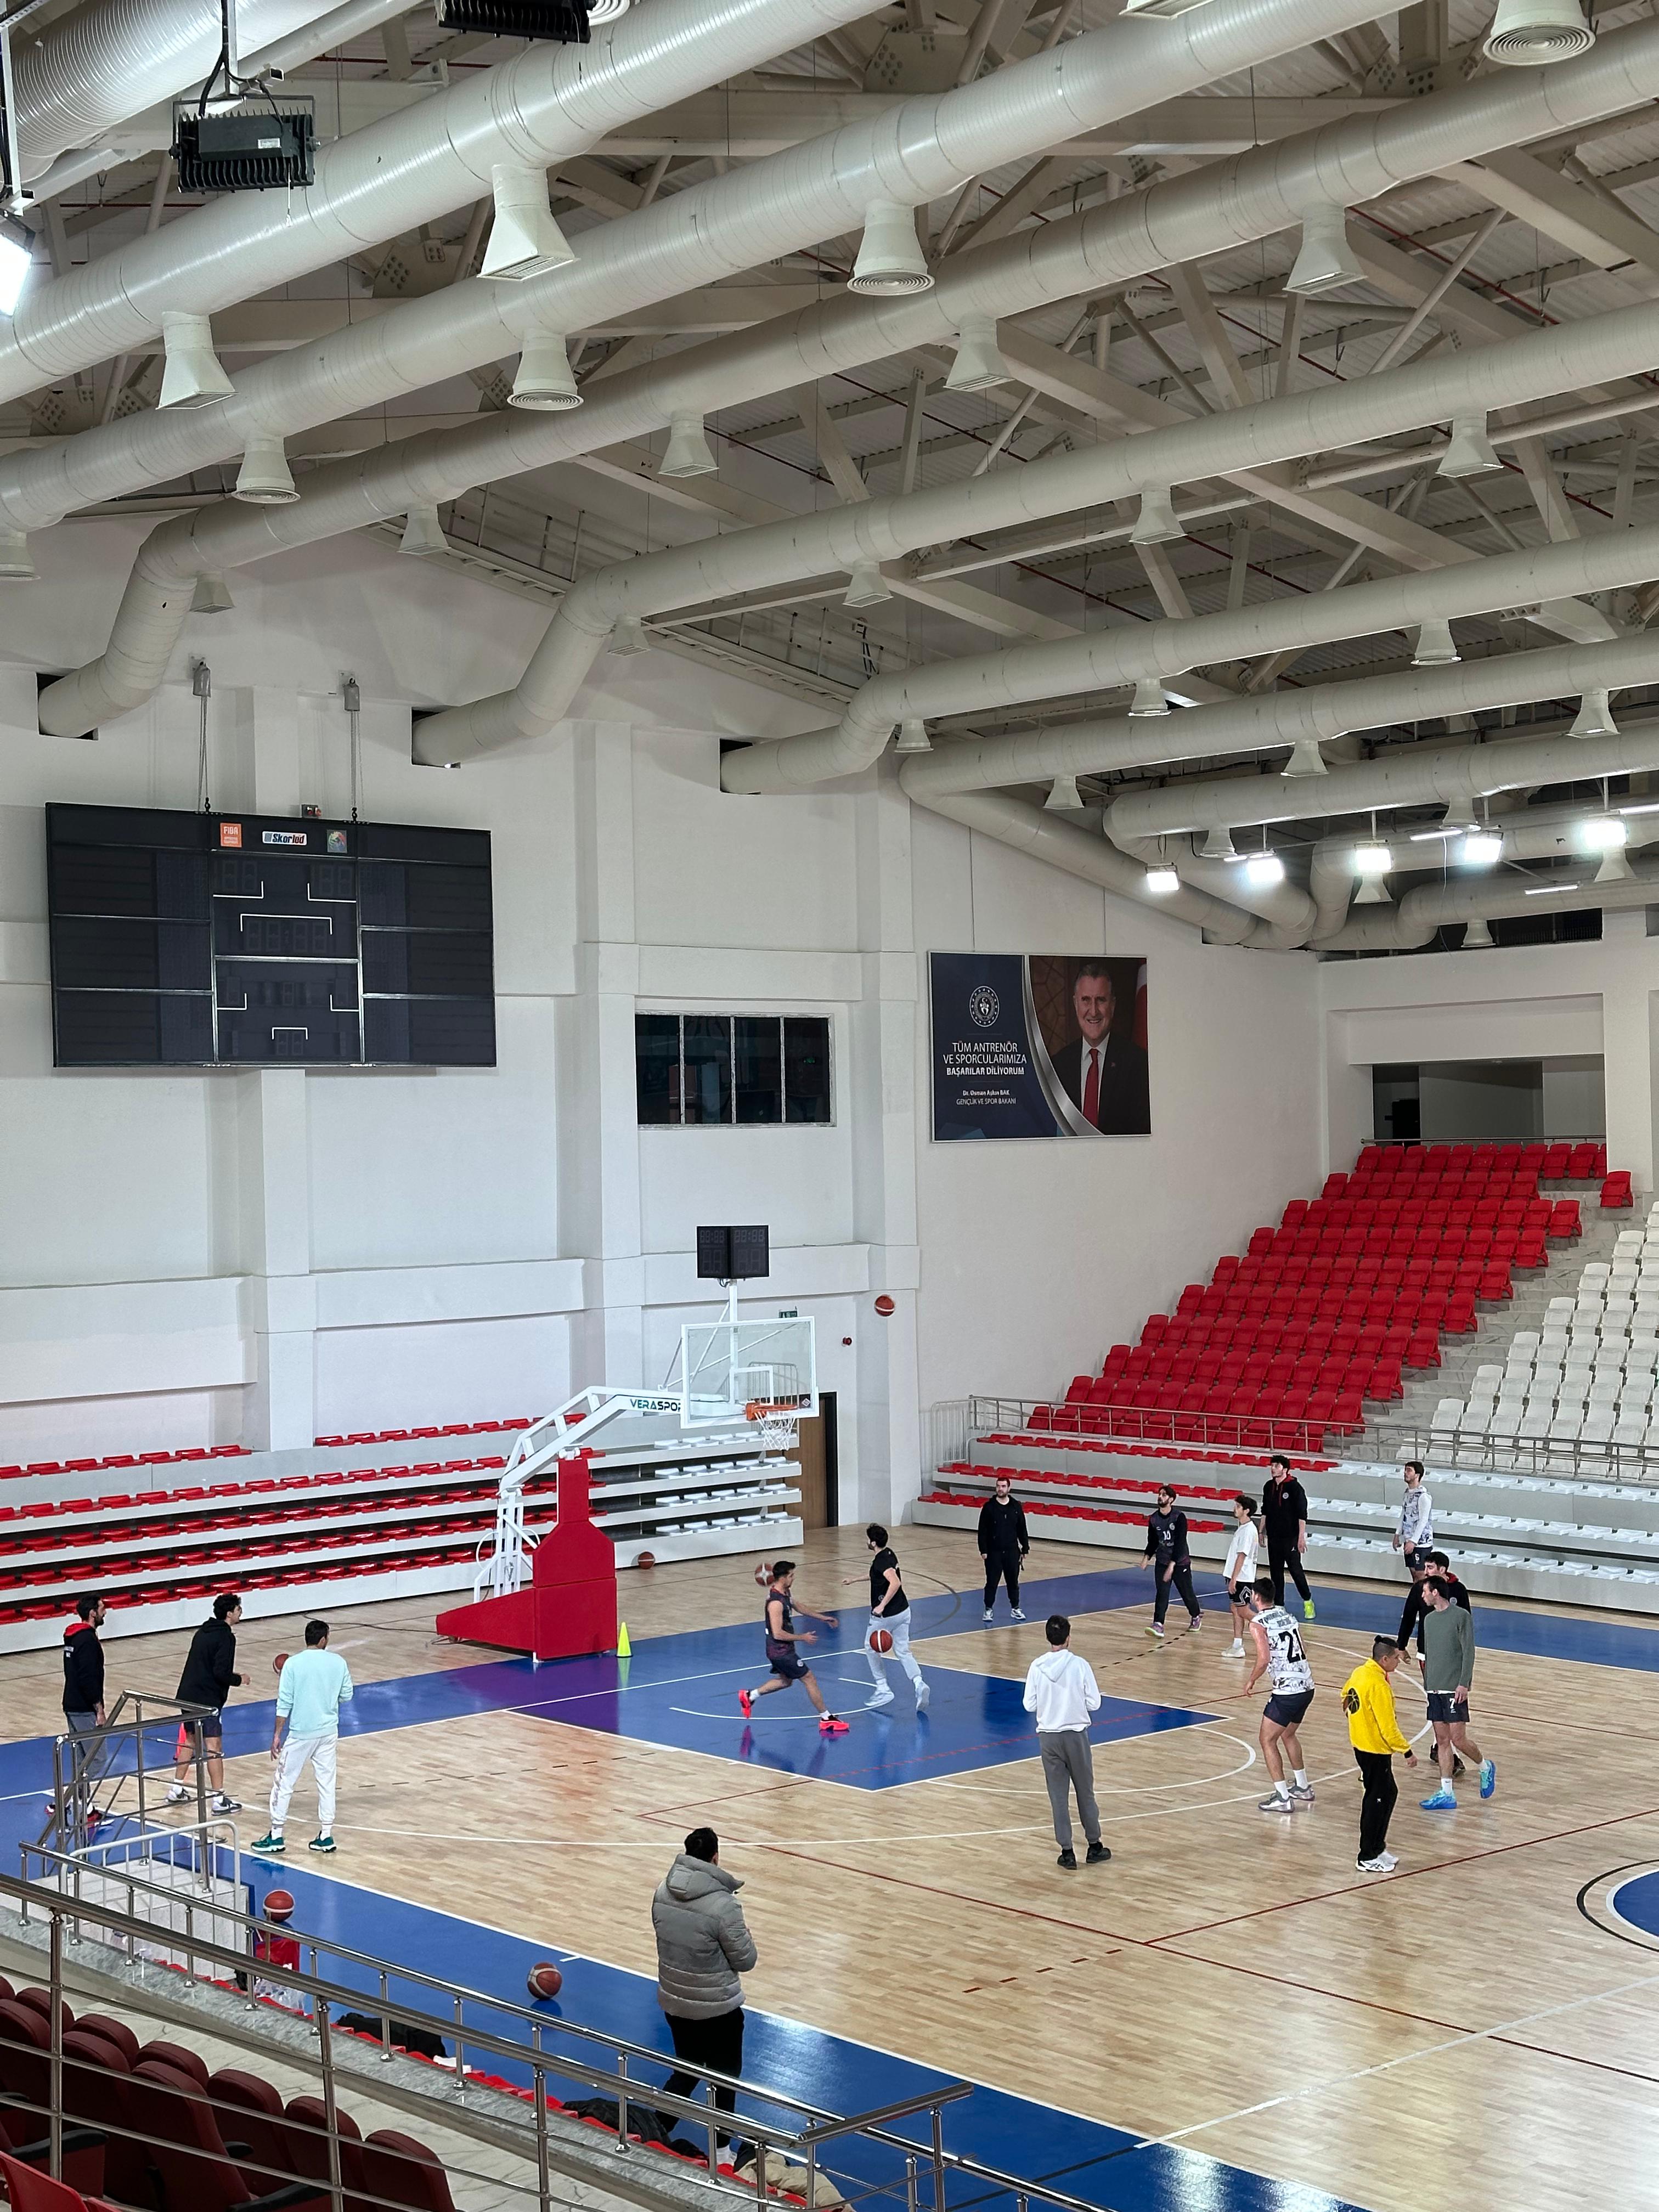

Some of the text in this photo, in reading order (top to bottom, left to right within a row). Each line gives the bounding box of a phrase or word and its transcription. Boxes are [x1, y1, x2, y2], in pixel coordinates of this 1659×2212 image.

[224, 826, 238, 835] FIBA
[952, 1040, 1018, 1053] TÜM ANTRENÖR
[943, 1054, 1027, 1064] VE SPORCULARIMIZA
[946, 1065, 1024, 1077] BAŞARILAR DİLİYORUM
[1163, 1530, 1171, 1540] 10
[1278, 1628, 1306, 1663] 21
[1449, 1698, 1455, 1709] 7
